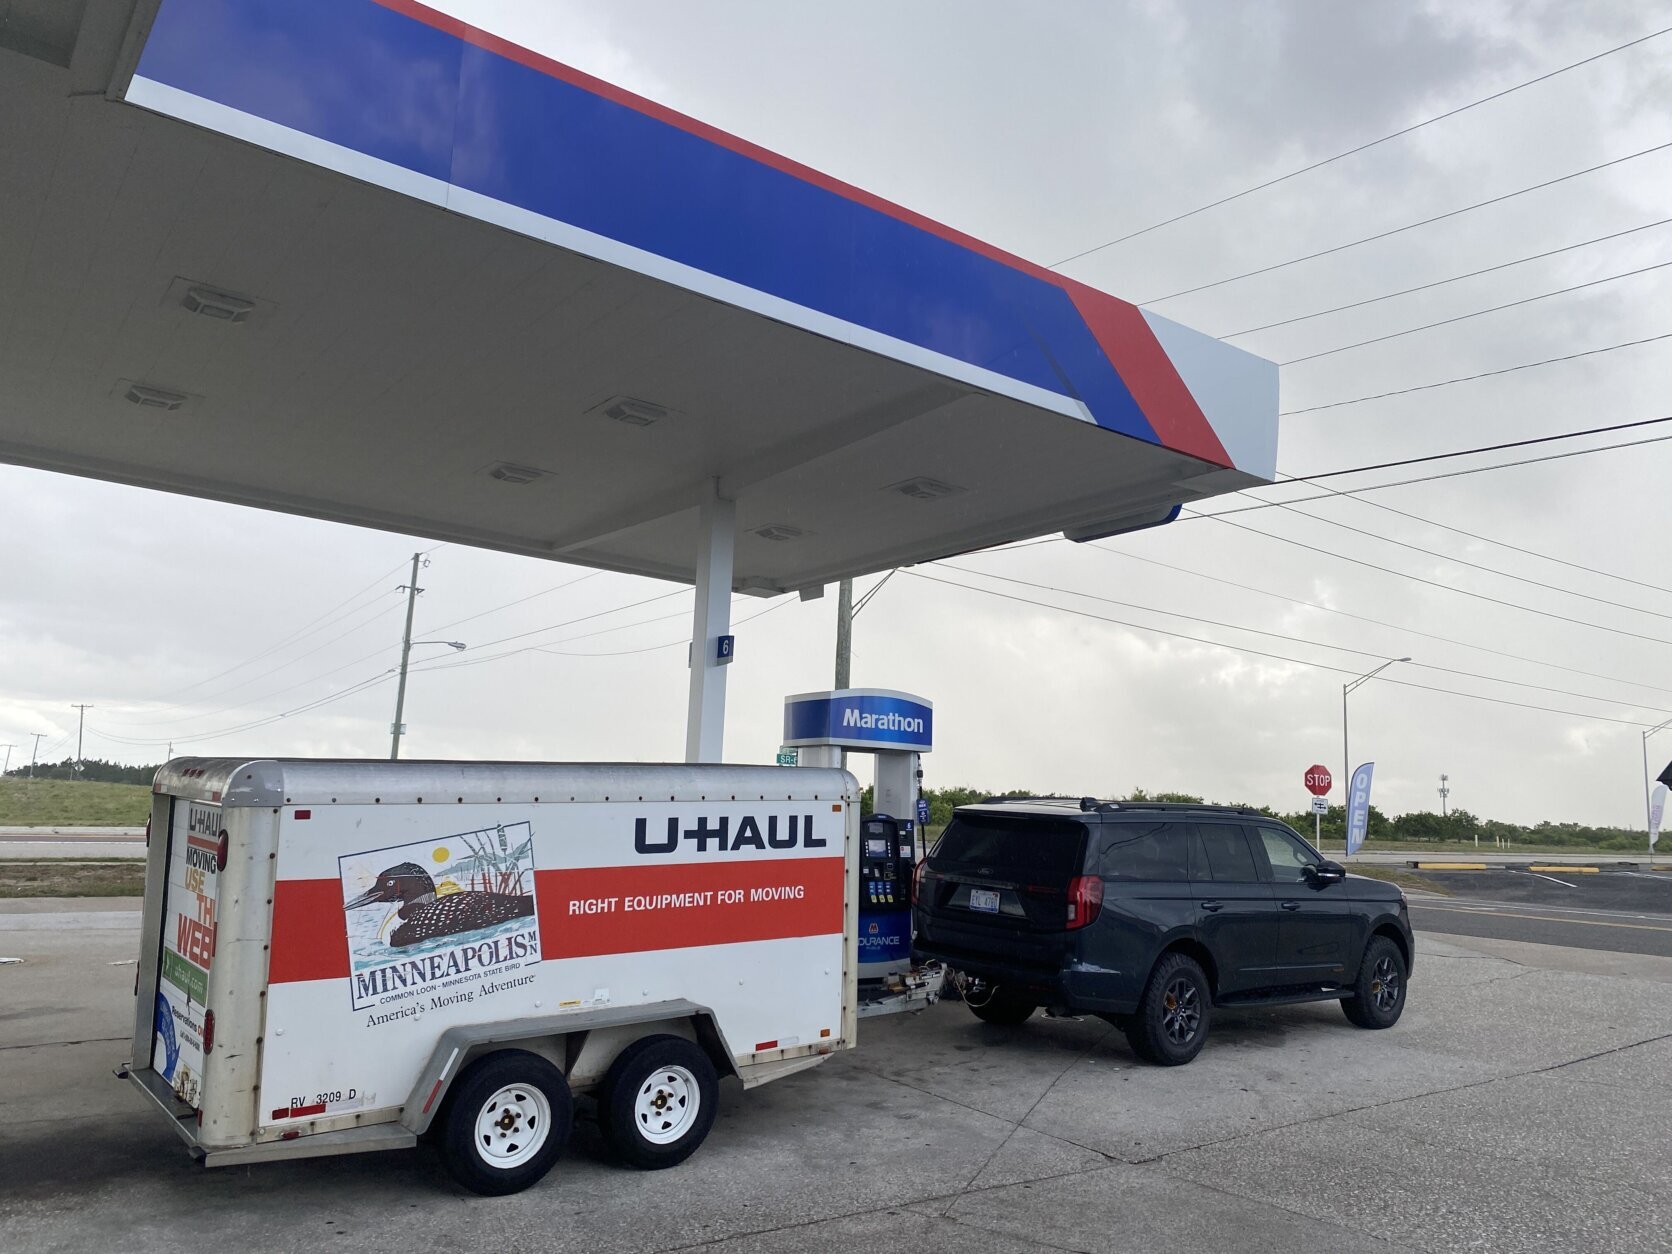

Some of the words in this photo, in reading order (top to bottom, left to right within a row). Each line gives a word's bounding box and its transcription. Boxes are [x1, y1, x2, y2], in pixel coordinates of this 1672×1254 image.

[722, 639, 729, 655] 6
[842, 708, 924, 734] Marathon
[1306, 774, 1331, 787] STOP
[1351, 773, 1369, 845] OPEN
[634, 815, 827, 854] U-HAUL
[186, 847, 216, 875] MOVING
[185, 866, 206, 895] USE
[568, 896, 618, 916] RIGHT
[624, 891, 713, 912] EQUIPMENT
[717, 889, 744, 905] FOR
[750, 885, 805, 902] MOVING
[177, 913, 212, 970] WEB
[356, 933, 528, 999] MINNEAPOLIS
[380, 989, 415, 1005] COMMON
[416, 984, 437, 996] LOON
[442, 973, 482, 989] MINNESOTA
[483, 968, 504, 979] STATE
[504, 962, 521, 974] BIRD
[366, 1000, 426, 1028] America's
[431, 988, 474, 1011] Moving
[479, 974, 536, 998] Adventure
[171, 1005, 198, 1034] Reservations
[290, 1096, 306, 1108] RV
[316, 1091, 342, 1105] 3209
[348, 1088, 357, 1100] D
